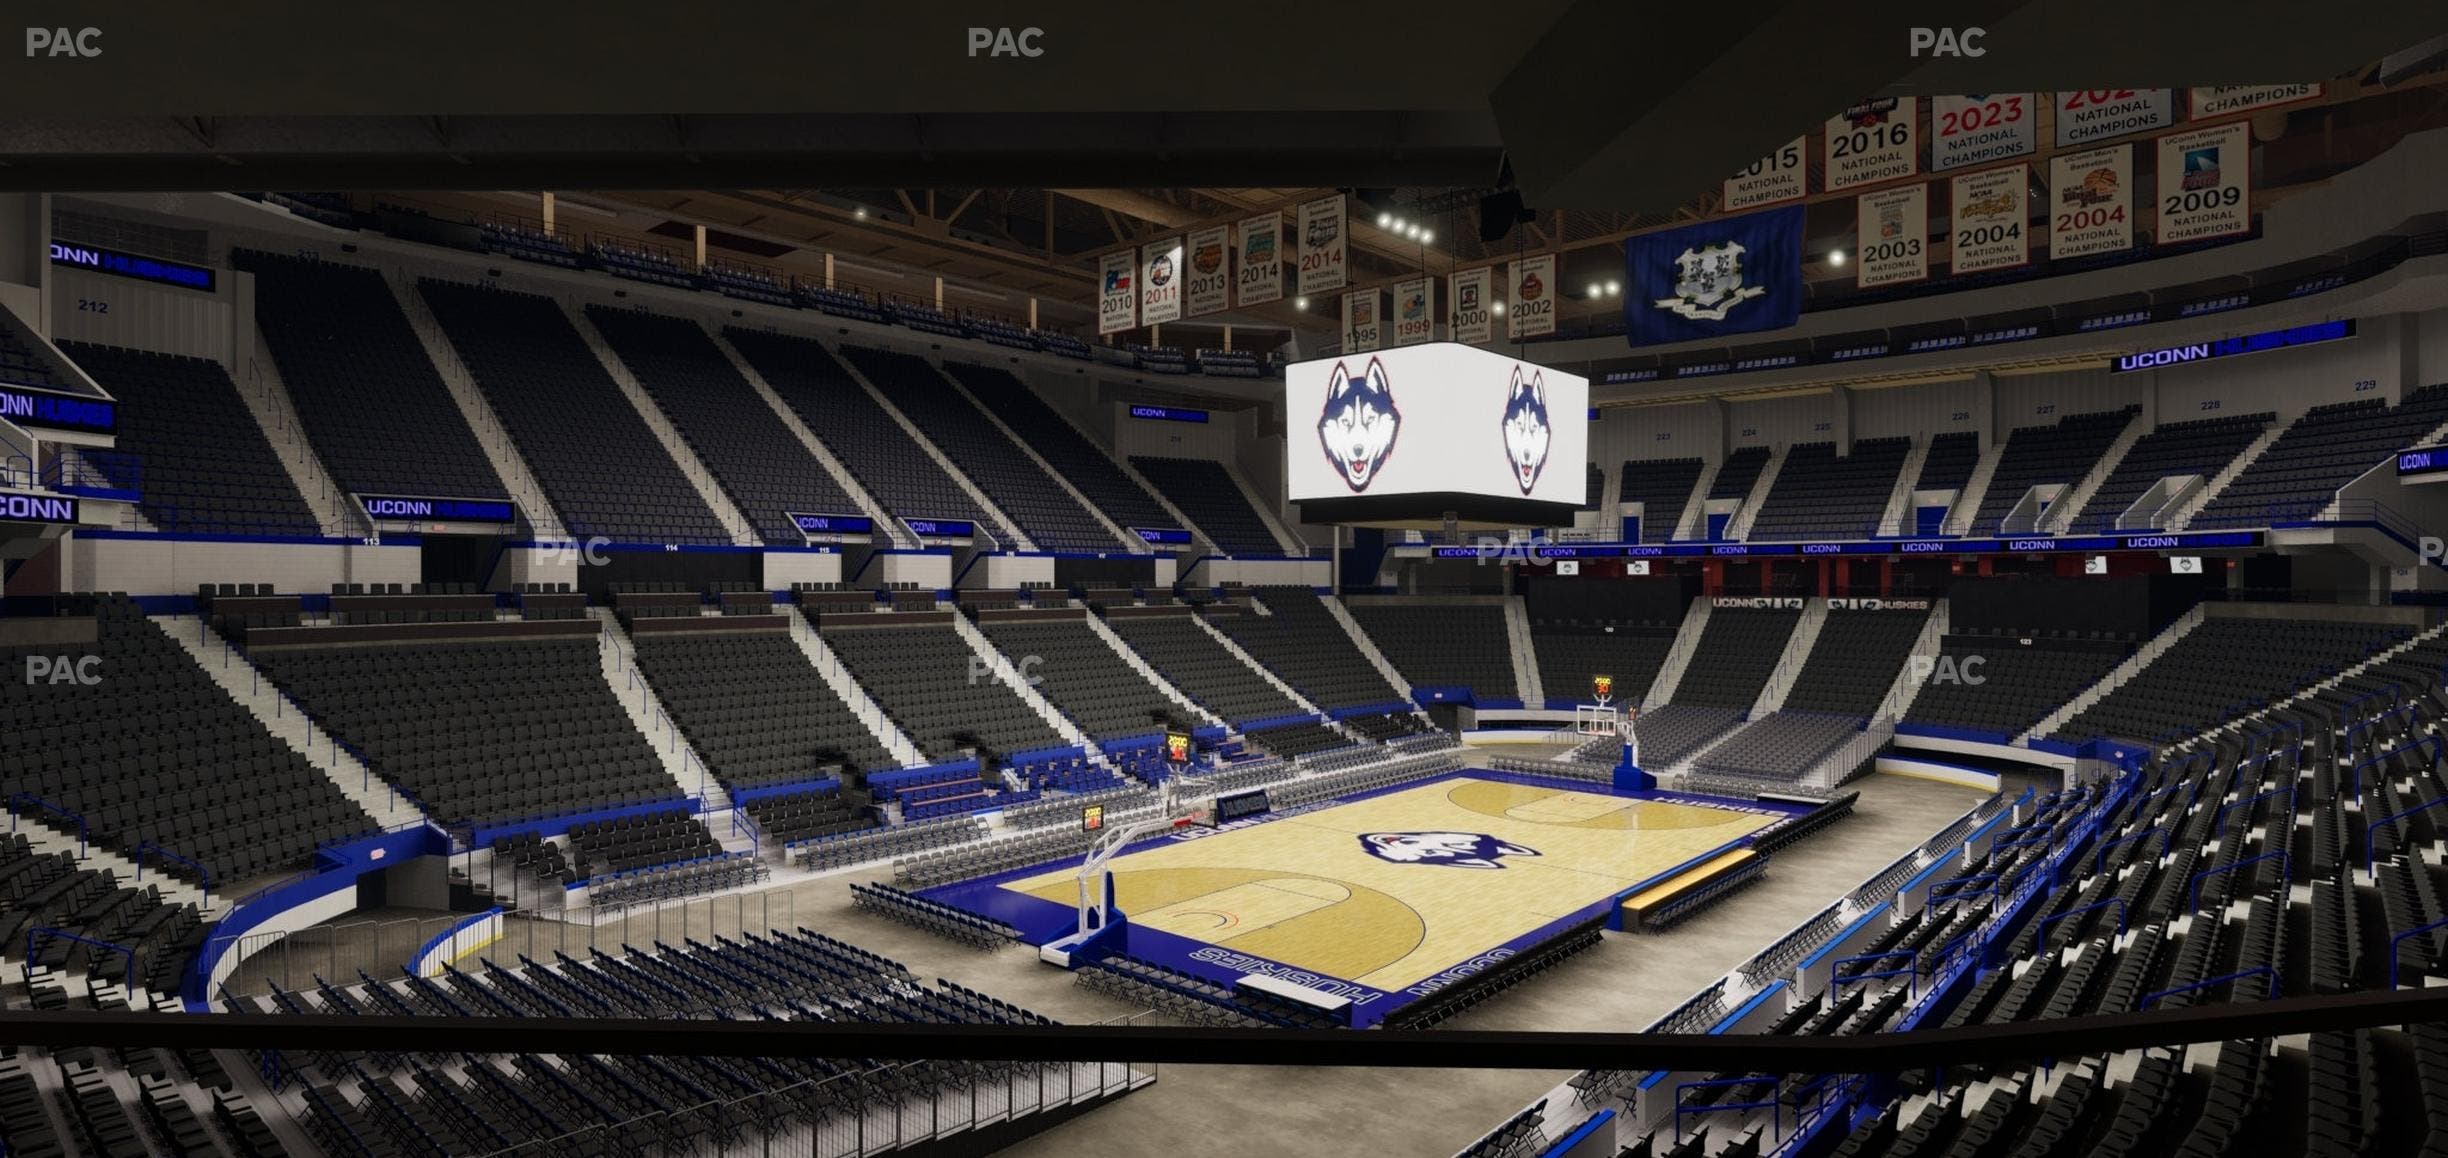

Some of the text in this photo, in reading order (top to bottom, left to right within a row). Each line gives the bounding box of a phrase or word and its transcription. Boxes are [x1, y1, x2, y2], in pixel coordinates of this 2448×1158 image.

[2204, 83, 2310, 113] CHAMPIONS
[1941, 96, 2022, 137] 2023
[2075, 99, 2152, 123] NATIONAL
[2068, 112, 2159, 140] CHAMPIONS
[1832, 122, 1909, 159] 2016
[1948, 127, 2018, 151] NATIONAL
[1841, 151, 1902, 171] NATIONAL
[1943, 141, 2024, 167] CHAMPIONS
[1738, 174, 1793, 193] NATIONAL
[1835, 163, 1909, 187] CHAMPIONS
[1732, 186, 1800, 207] CHAMPIONS
[2165, 186, 2240, 215] 2009
[2057, 204, 2125, 232] 2004
[2174, 210, 2235, 226] NATIONAL
[1958, 222, 2020, 248] 2004
[2065, 227, 2120, 243] NATIONAL
[2167, 221, 2241, 239] CHAMPIONS
[1864, 239, 1920, 263] 2003
[1966, 244, 2016, 258] NATIONAL
[2059, 239, 2126, 255] CHAMPIONS
[1302, 248, 1341, 272] 2014
[1870, 259, 1917, 272] NATIONAL
[1960, 254, 2021, 270] CHAMPIONS
[1241, 262, 1278, 284] 2014
[1865, 269, 1922, 284] CHAMPIONS
[1191, 275, 1225, 295] 2013
[1102, 295, 1132, 314] 2010
[1145, 287, 1177, 305] 2011
[78, 299, 108, 314] 212
[1512, 300, 1551, 318] 2002
[1398, 319, 1430, 337] 1999
[2120, 343, 2209, 371] UCONN
[2355, 380, 2376, 391] 229
[1132, 407, 1167, 419] UCONN
[2037, 405, 2055, 414] 227
[2400, 451, 2431, 471] UCONN
[368, 500, 431, 516] UCONN
[363, 537, 380, 546] 113
[1712, 546, 1748, 555] UCONN
[1803, 544, 1841, 554] UCONN
[1901, 542, 1943, 553] UCONN
[2009, 540, 2055, 551] UCONN
[2127, 536, 2178, 548] UCONN
[1439, 547, 1479, 557] UCONN
[1540, 547, 1576, 557] UCONN
[1628, 547, 1662, 556] UCONN
[1713, 598, 1755, 608] UCONN
[1881, 600, 1928, 610] HUSKIES
